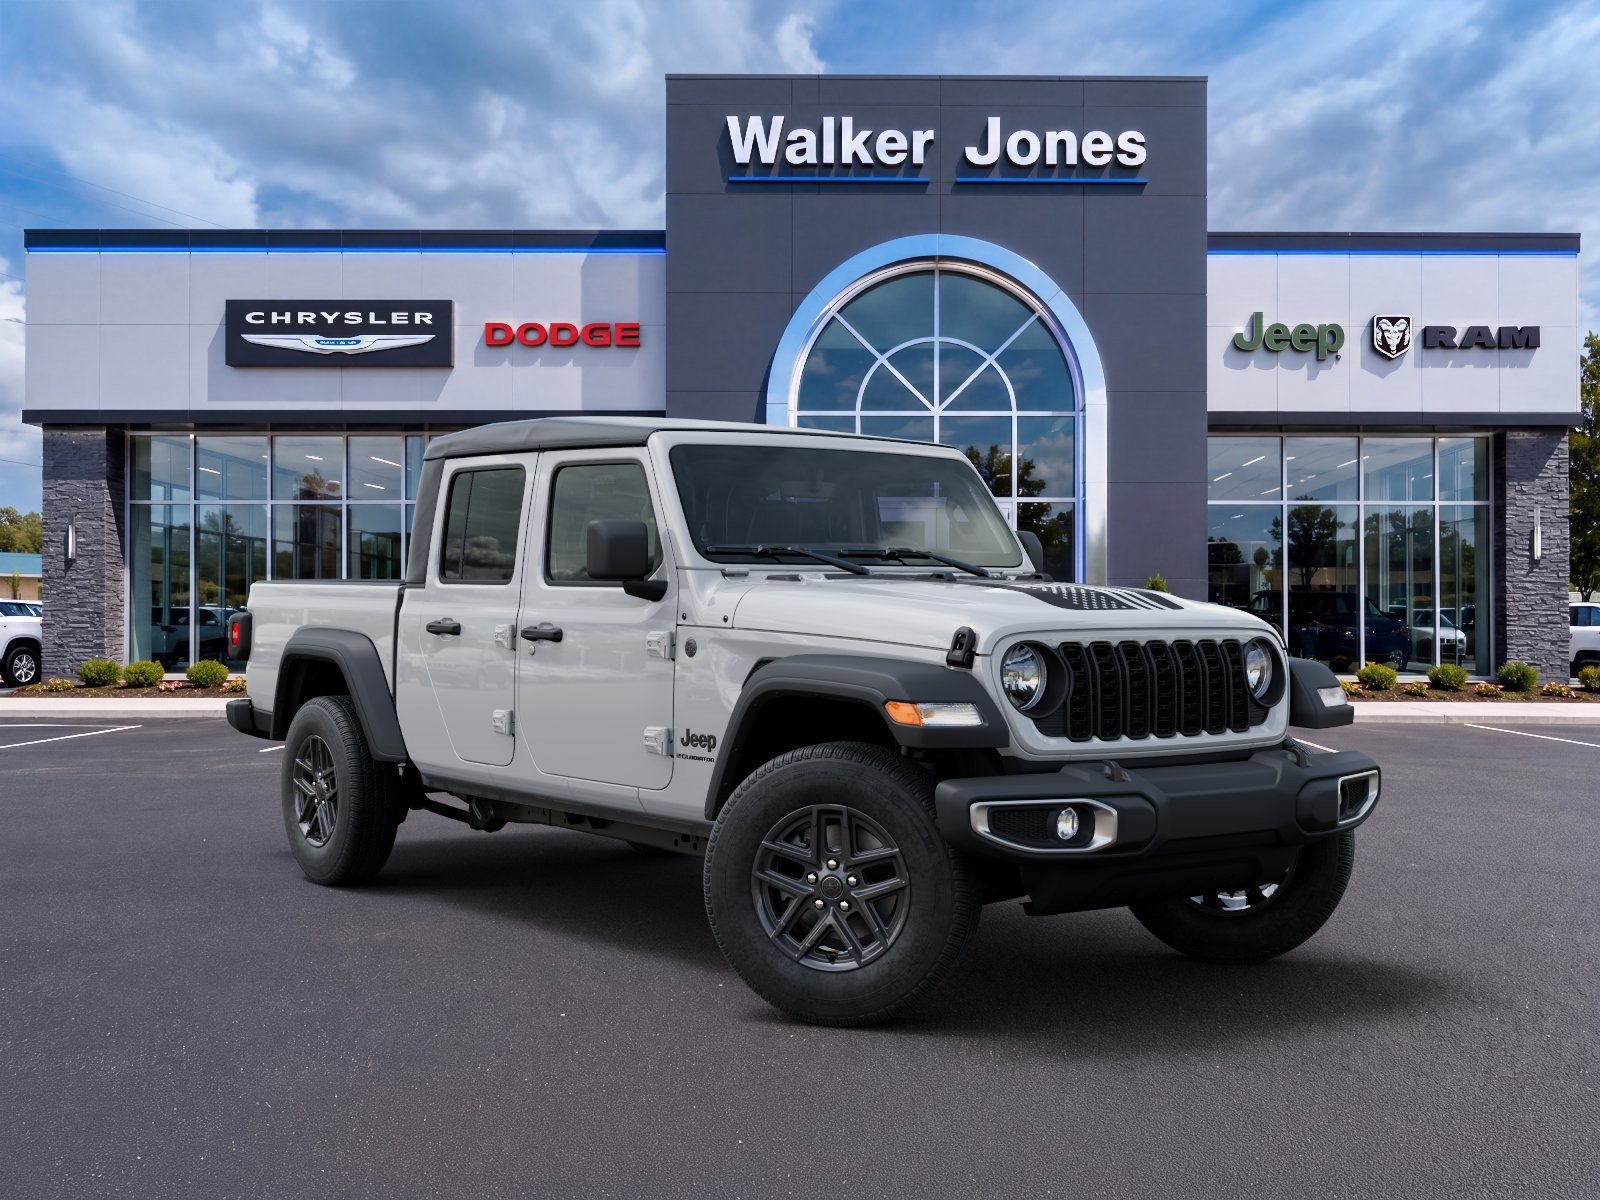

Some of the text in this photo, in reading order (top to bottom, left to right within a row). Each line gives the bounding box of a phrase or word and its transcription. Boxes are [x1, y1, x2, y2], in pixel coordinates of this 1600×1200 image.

[726, 115, 1148, 166] Walker Jones
[245, 311, 433, 325] CHRYSLER
[485, 322, 641, 347] DODGE
[1234, 311, 1345, 361] Jeep
[1425, 325, 1541, 349] RAM
[681, 728, 717, 752] Jeep
